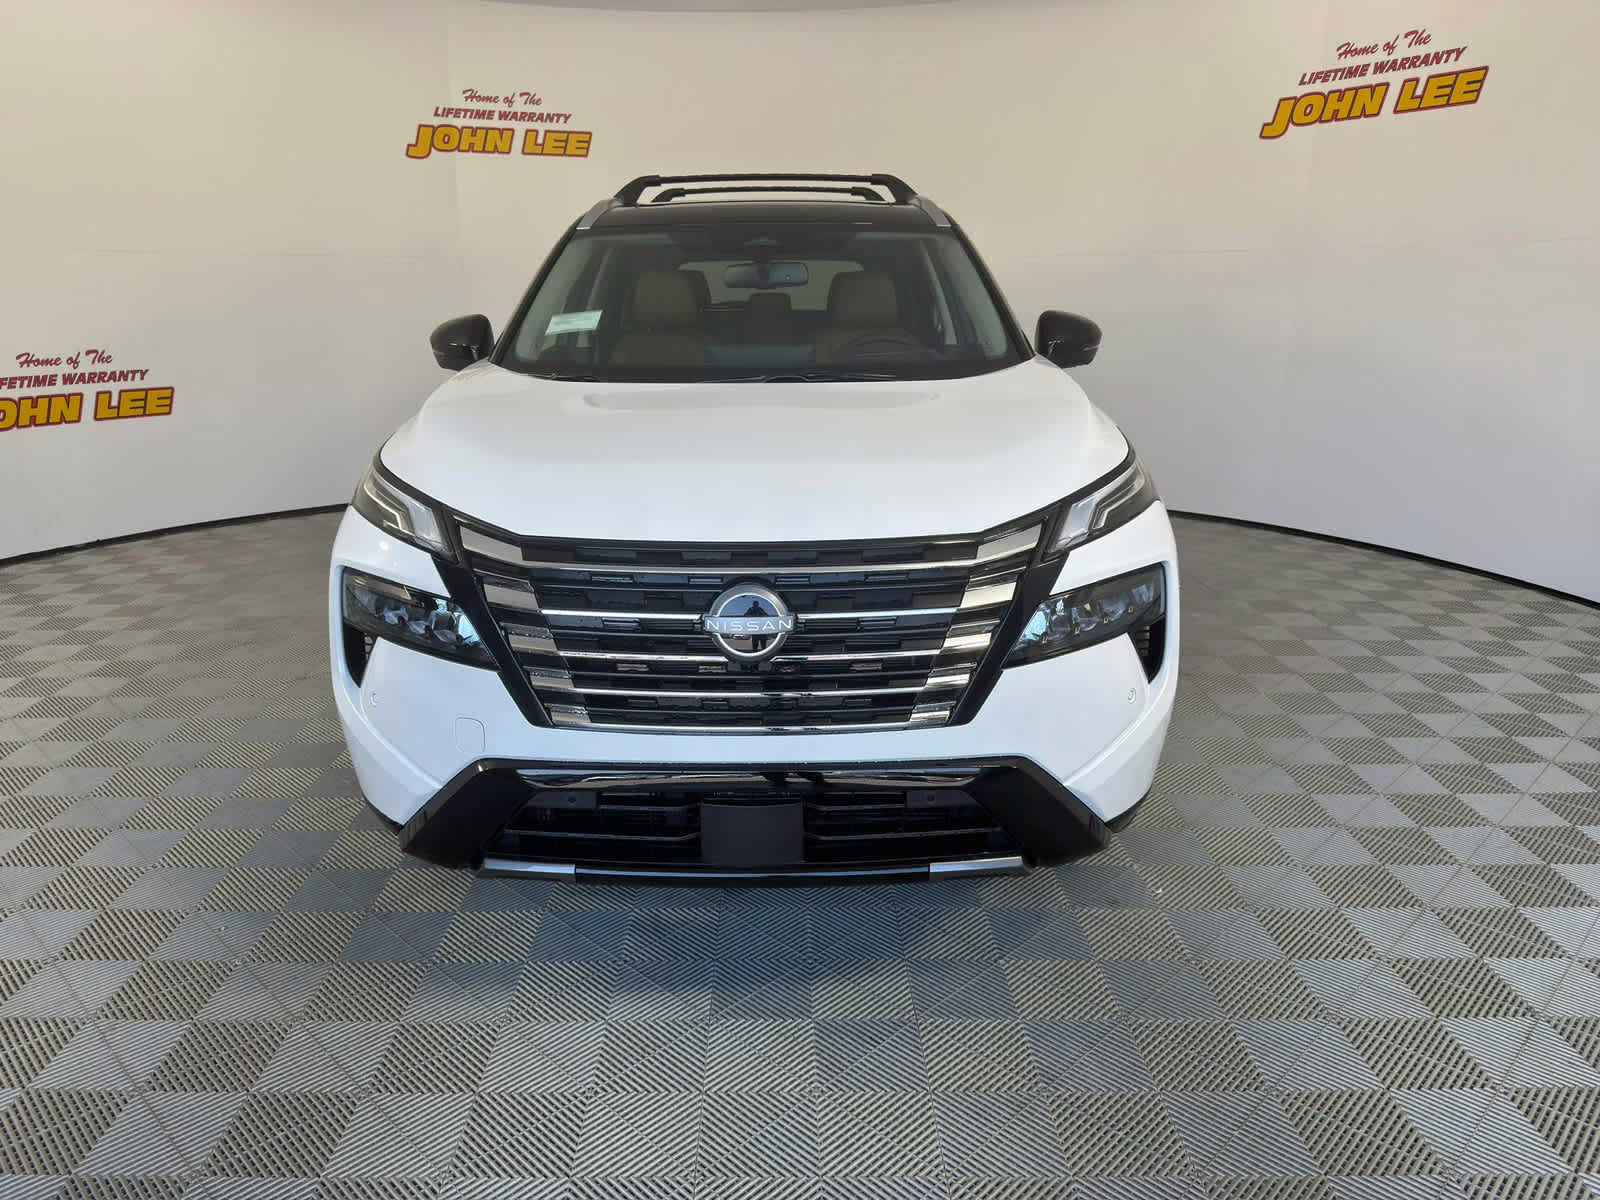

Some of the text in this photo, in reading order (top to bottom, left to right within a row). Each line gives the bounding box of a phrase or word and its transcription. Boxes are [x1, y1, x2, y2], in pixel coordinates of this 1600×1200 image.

[1336, 29, 1432, 60] Home of The
[1298, 46, 1467, 86] LIFETIME WARRANTY
[462, 88, 543, 108] Home of The
[1259, 65, 1489, 139] JOHN LEE
[433, 106, 572, 124] LIFETIME WARRANTY
[406, 124, 592, 159] JOHN LEE
[16, 349, 113, 370] Home of The
[62, 369, 149, 386] WARRANTY
[94, 386, 175, 422] LEE
[706, 619, 792, 632] NISSAN
